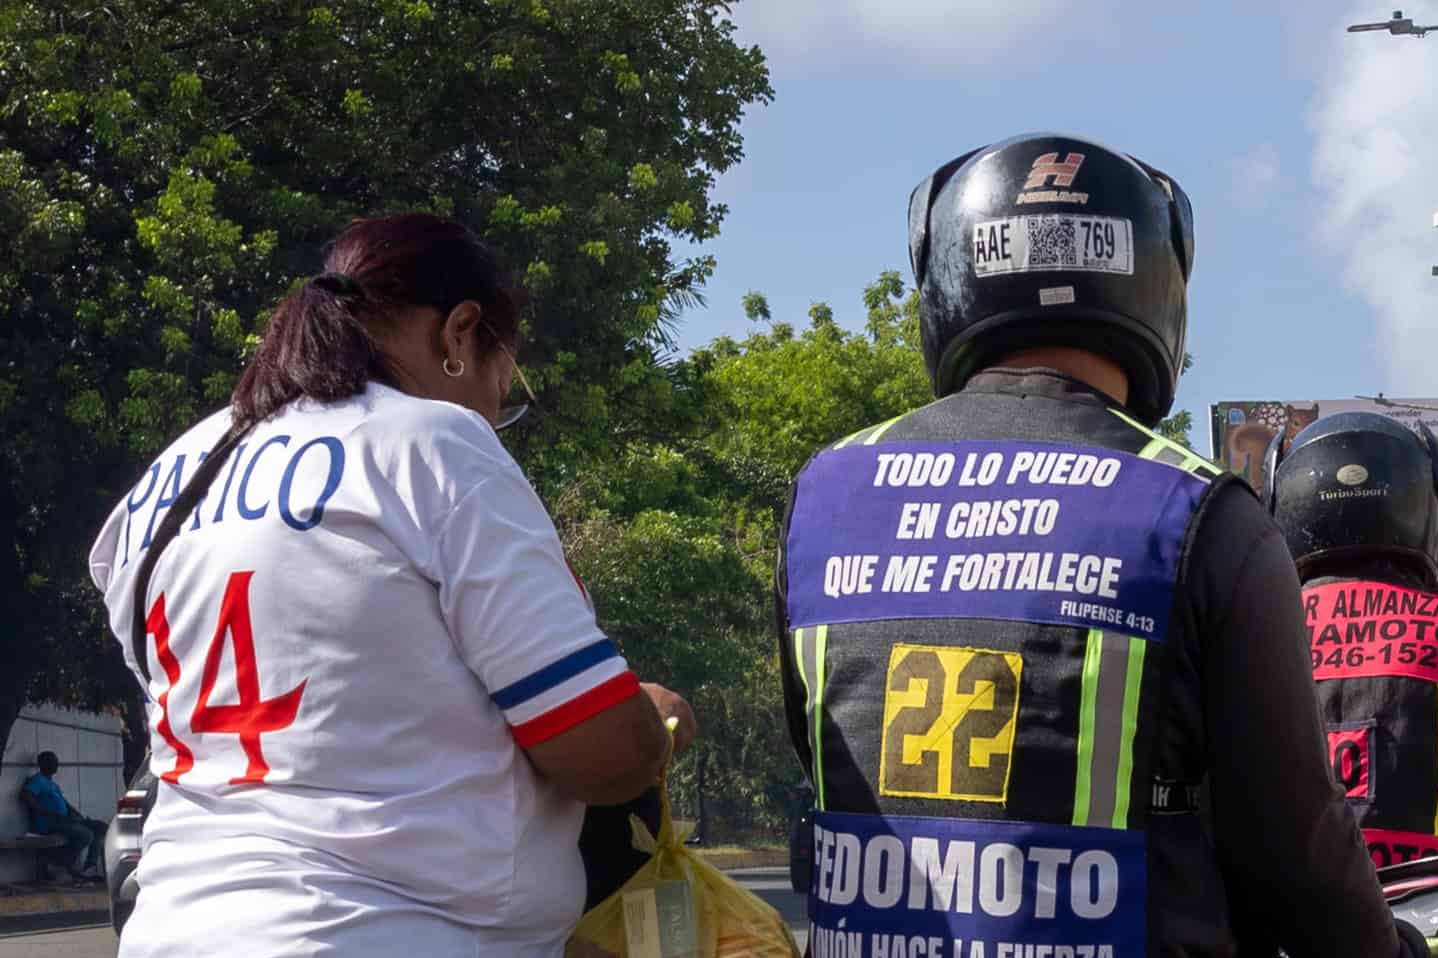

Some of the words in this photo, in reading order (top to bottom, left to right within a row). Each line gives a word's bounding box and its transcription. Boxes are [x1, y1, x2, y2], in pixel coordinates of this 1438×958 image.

[976, 224, 1012, 264] AAE
[1080, 221, 1115, 260] 769
[873, 453, 952, 488] TODO
[958, 452, 1000, 487] LO
[1006, 451, 1121, 488] PUEDO
[896, 502, 941, 540] EN
[945, 499, 1060, 540] CRISTO
[824, 555, 878, 598] QUE
[881, 555, 939, 593] ME
[940, 552, 1122, 599] FORTALECE
[1060, 600, 1124, 626] FILIPENSE
[1125, 612, 1155, 633] 4:13
[146, 570, 308, 786] 14
[885, 650, 1020, 797] 22
